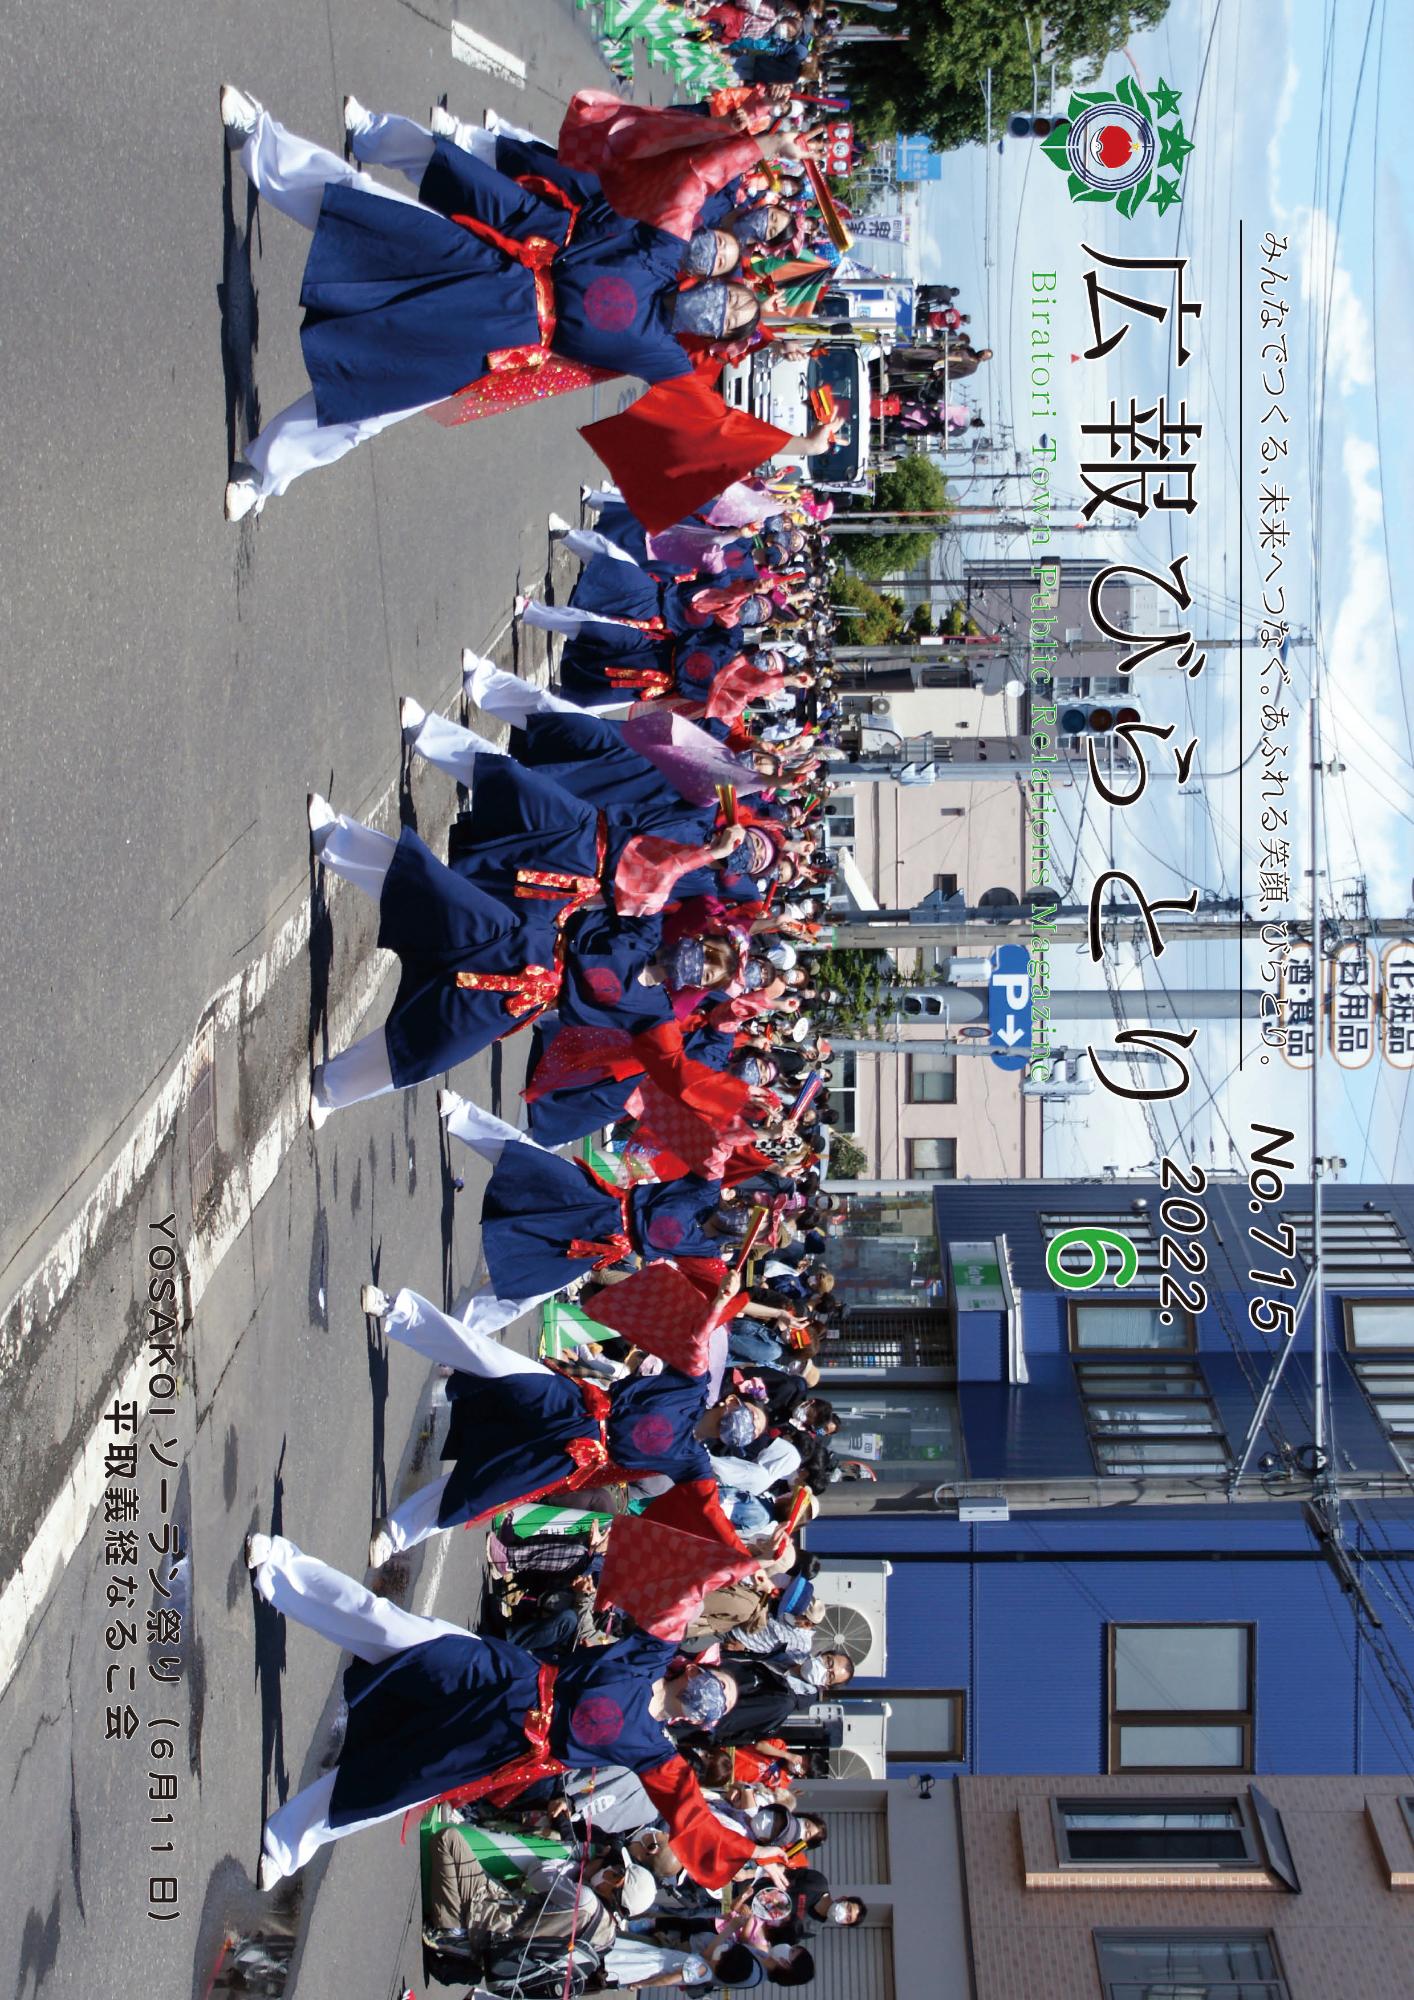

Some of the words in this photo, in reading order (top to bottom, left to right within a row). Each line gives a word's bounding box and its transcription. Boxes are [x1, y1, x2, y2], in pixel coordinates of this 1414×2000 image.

[992, 974, 1029, 1010] P
[1338, 961, 1369, 1053] 日用品
[1388, 960, 1414, 1054] 化粧品
